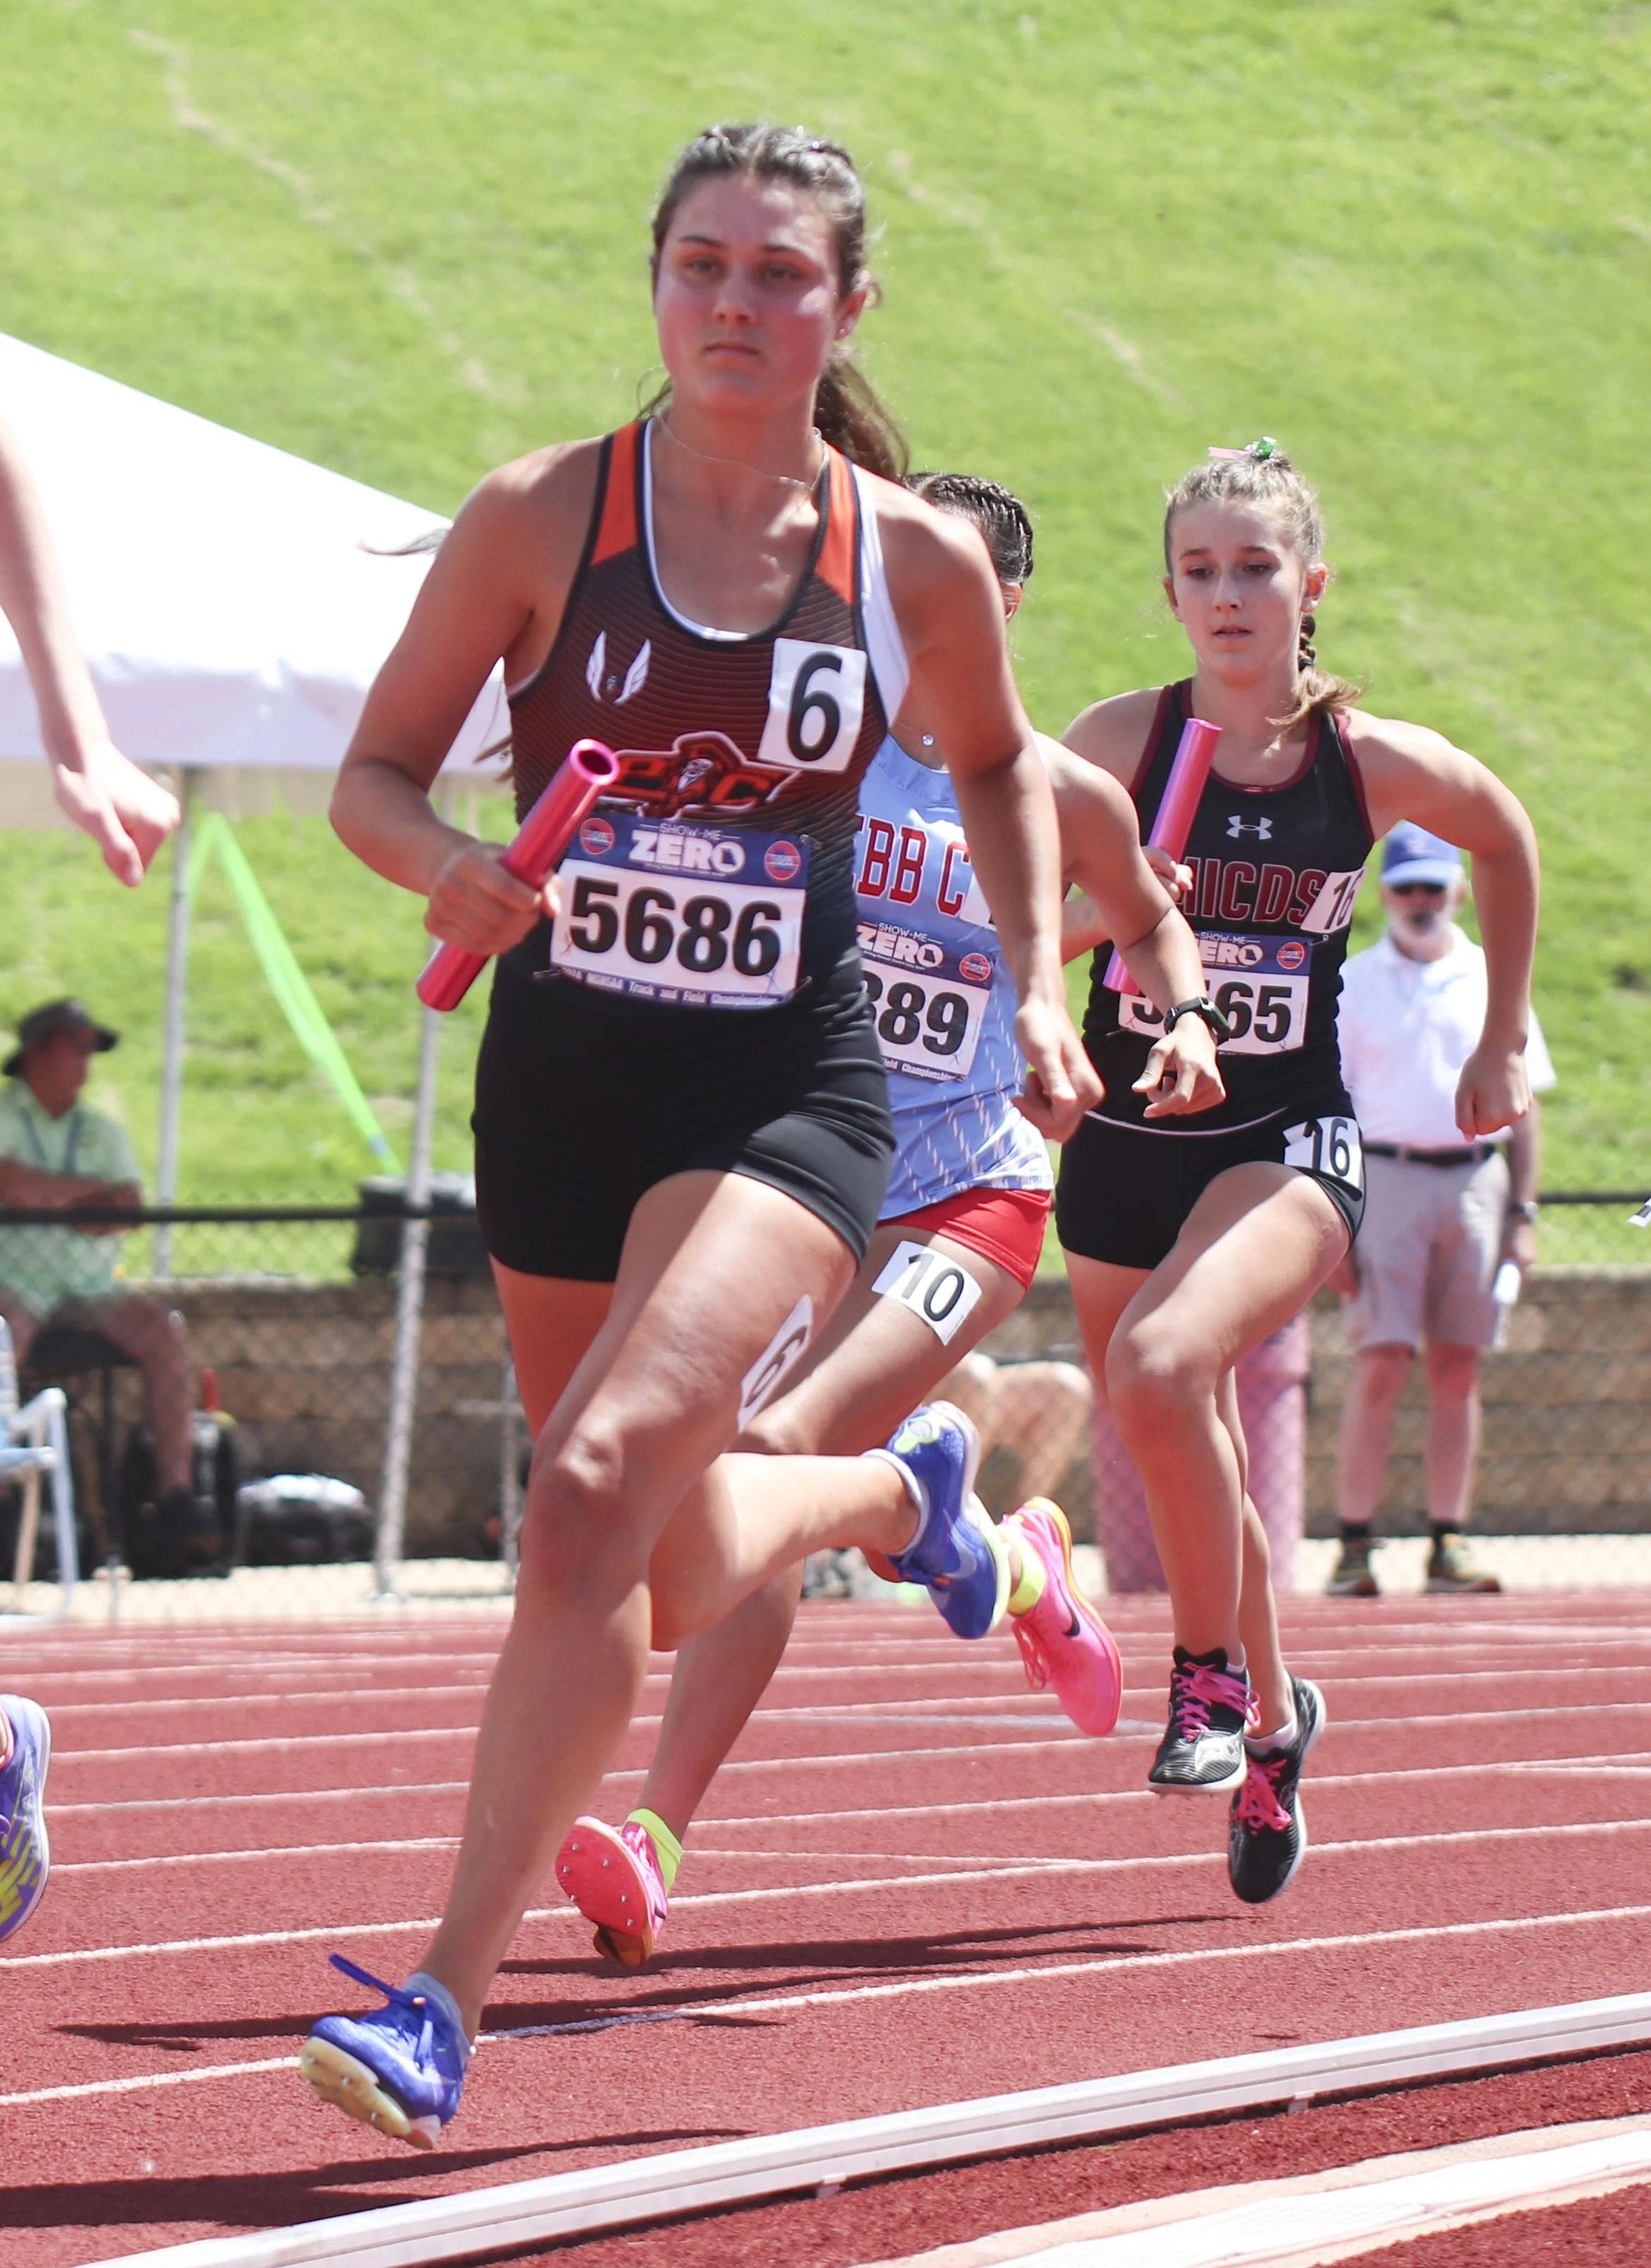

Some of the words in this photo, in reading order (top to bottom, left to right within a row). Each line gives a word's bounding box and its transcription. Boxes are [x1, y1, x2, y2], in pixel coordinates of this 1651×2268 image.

[786, 650, 843, 762] 6
[629, 830, 746, 875] ZERO
[659, 822, 723, 840] SHOW-ME
[853, 814, 929, 906] BB
[569, 875, 781, 976] 5686
[855, 924, 944, 967] ZERO
[879, 922, 929, 942] SHOW-ME
[1200, 931, 1247, 944] SHOW-ME
[1198, 939, 1263, 966] ERO
[1132, 979, 1292, 1043] 65
[882, 1058, 898, 1069] ield
[1302, 1117, 1351, 1177] 16
[901, 1252, 965, 1322] 10
[743, 1324, 807, 1408] 6
